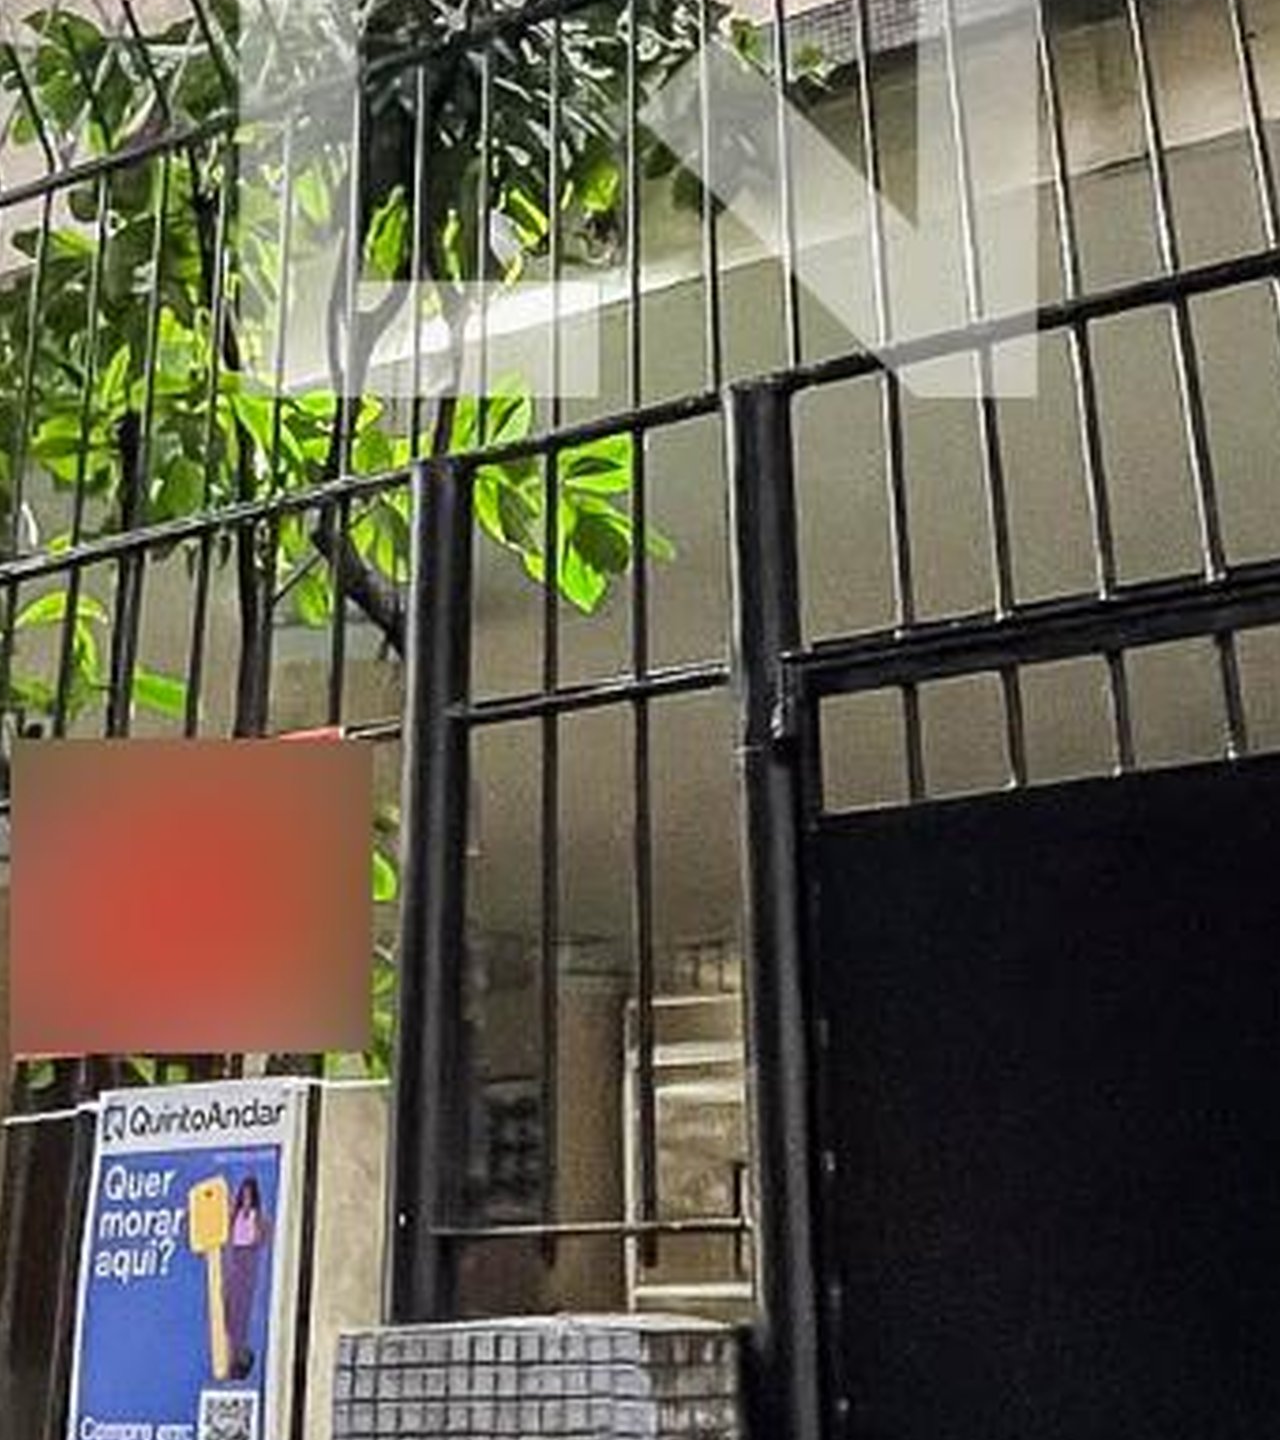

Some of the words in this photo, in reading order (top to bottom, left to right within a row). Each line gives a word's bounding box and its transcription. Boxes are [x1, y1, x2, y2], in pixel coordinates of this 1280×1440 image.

[129, 1098, 286, 1136] QuintoAndar
[105, 1164, 176, 1201] Quer
[99, 1208, 185, 1239] morar
[95, 1236, 175, 1284] aqui?
